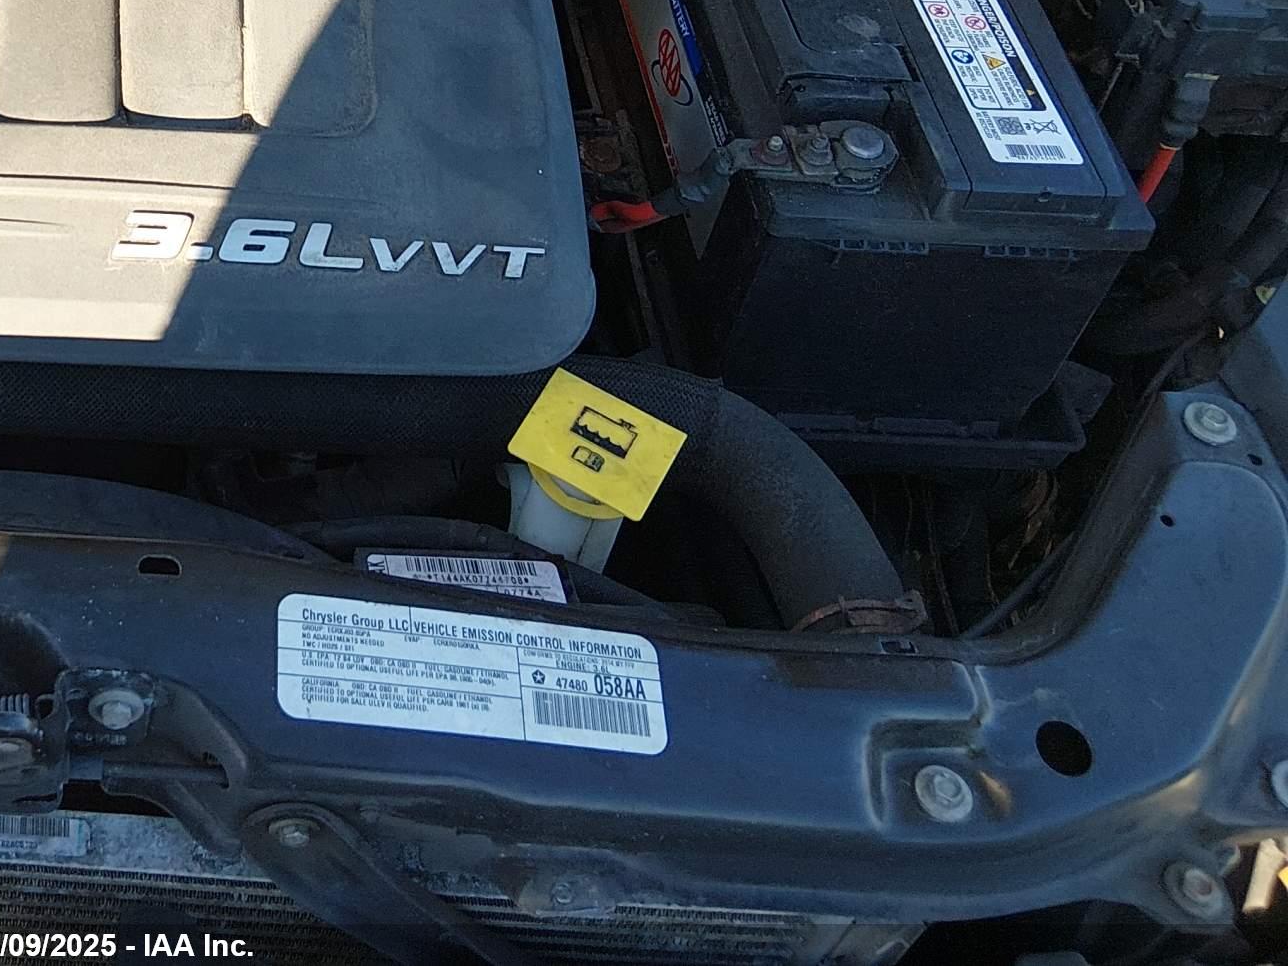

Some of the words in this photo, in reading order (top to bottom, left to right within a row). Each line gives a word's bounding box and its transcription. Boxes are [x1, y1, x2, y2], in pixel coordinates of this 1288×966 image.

[110, 209, 365, 270] 3.6L
[368, 237, 547, 279] VVT
[302, 608, 348, 625] Chrysler
[351, 613, 385, 631] Group
[388, 619, 410, 632] LLC
[414, 621, 458, 638] VEHICLE
[461, 627, 513, 644] EMISSION
[516, 633, 565, 651] CONTROL
[569, 641, 642, 660] INFORMATION
[555, 677, 589, 692] 47480
[593, 674, 647, 700] 058AA
